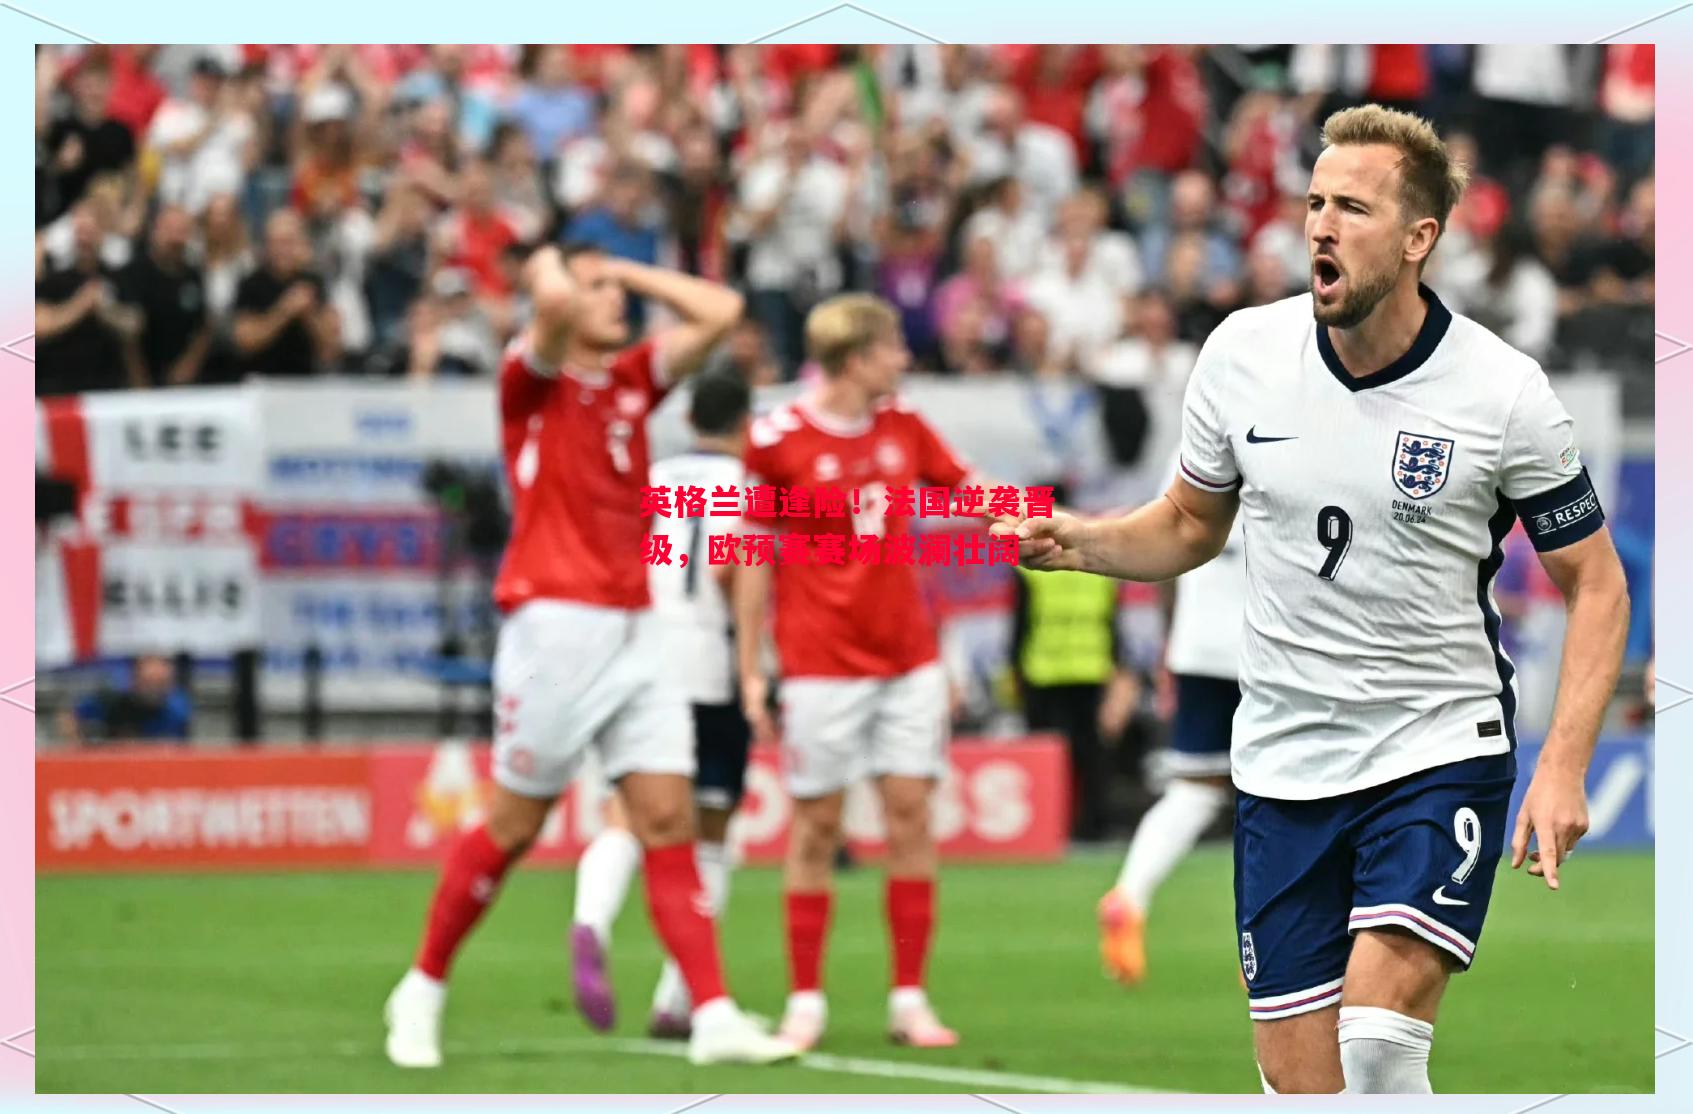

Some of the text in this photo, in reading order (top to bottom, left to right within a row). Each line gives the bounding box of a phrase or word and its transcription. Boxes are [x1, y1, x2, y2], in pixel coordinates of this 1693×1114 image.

[1392, 499, 1432, 516] DENMARK
[1393, 511, 1426, 524] 20.06.24
[1317, 505, 1353, 581] 9
[1452, 806, 1482, 885] 9
